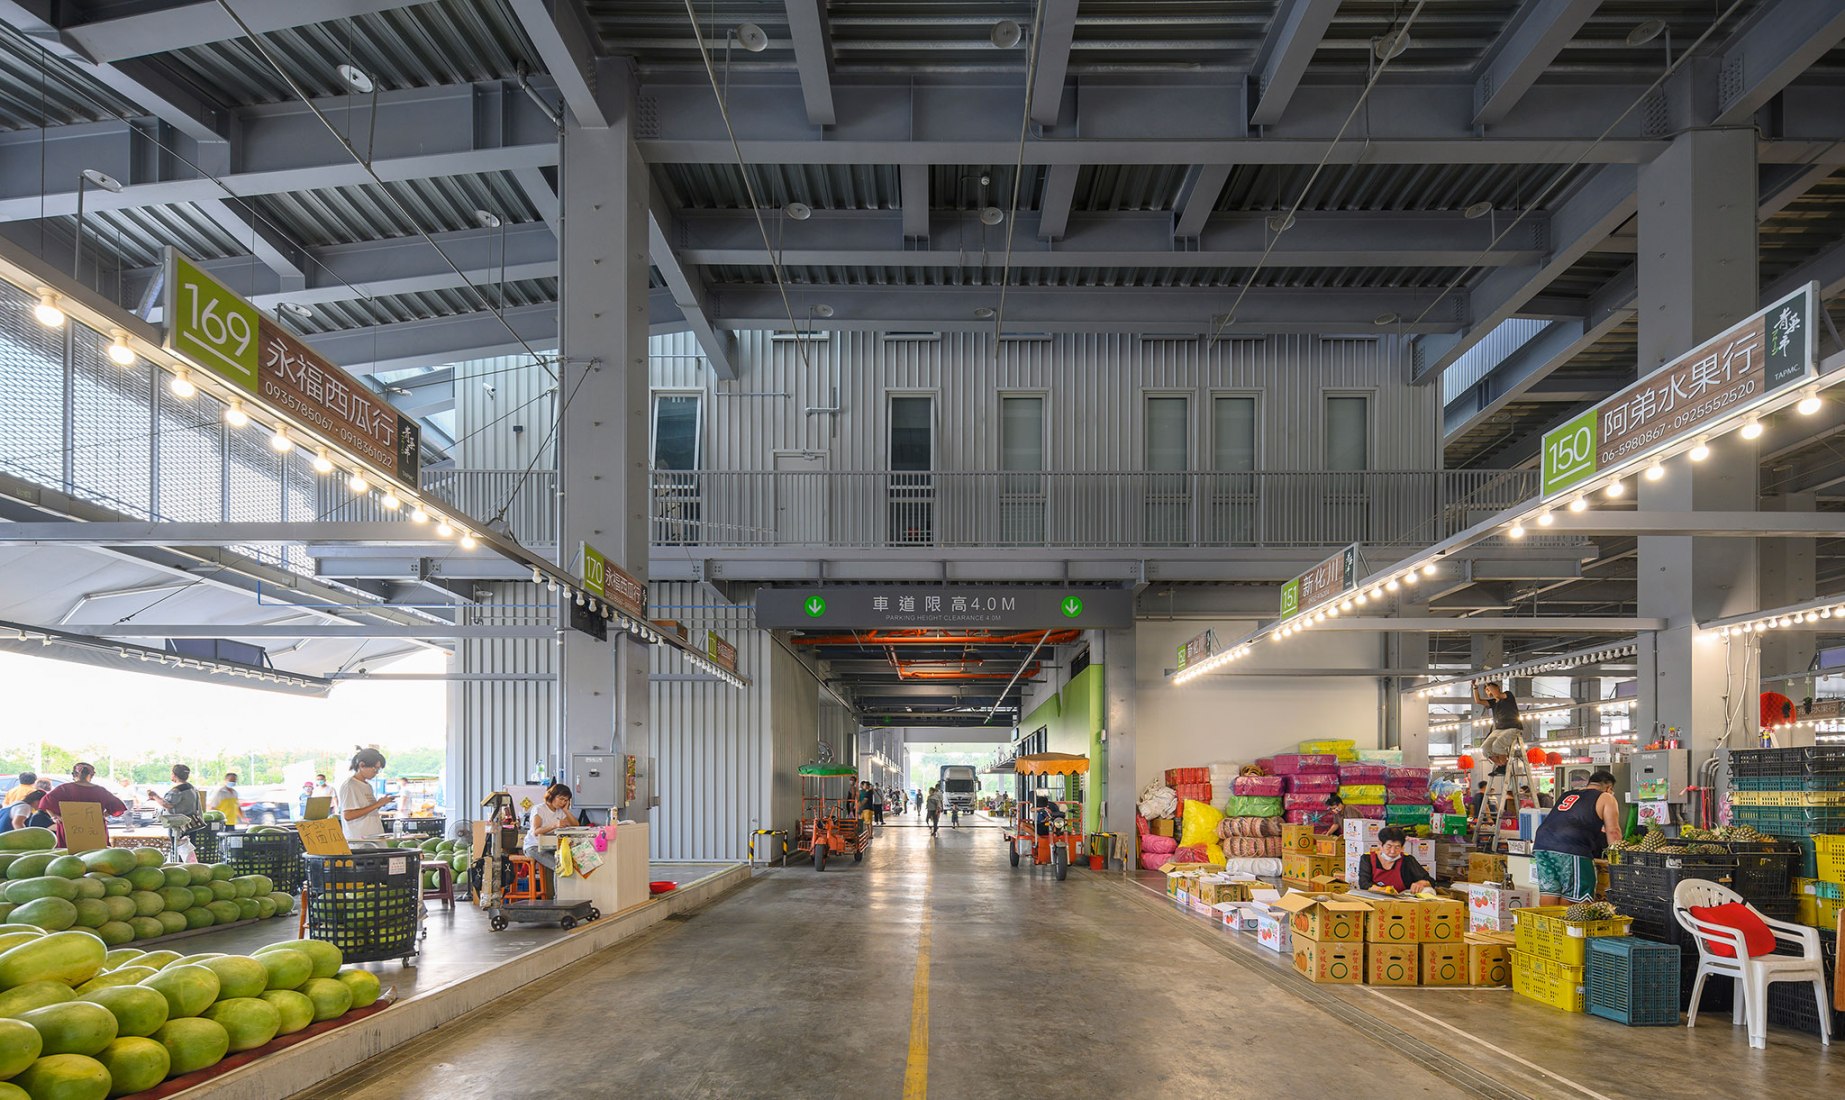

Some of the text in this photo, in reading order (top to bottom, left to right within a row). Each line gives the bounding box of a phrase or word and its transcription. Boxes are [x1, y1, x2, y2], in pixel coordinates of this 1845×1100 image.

[184, 283, 251, 357] 169
[266, 337, 395, 448] 永福西瓜行
[1604, 332, 1759, 445] 阿弟水果行
[265, 381, 393, 468] 0935785067 0918361022
[1548, 426, 1591, 475] 150
[1602, 379, 1756, 464] 06-5980867 0925552520
[586, 555, 603, 584] 170
[1284, 586, 1297, 609] 151
[885, 614, 916, 622] PARKING
[917, 614, 942, 622] HEIGHT
[944, 614, 984, 622] CLEARANCE
[1557, 794, 1580, 811] 9
